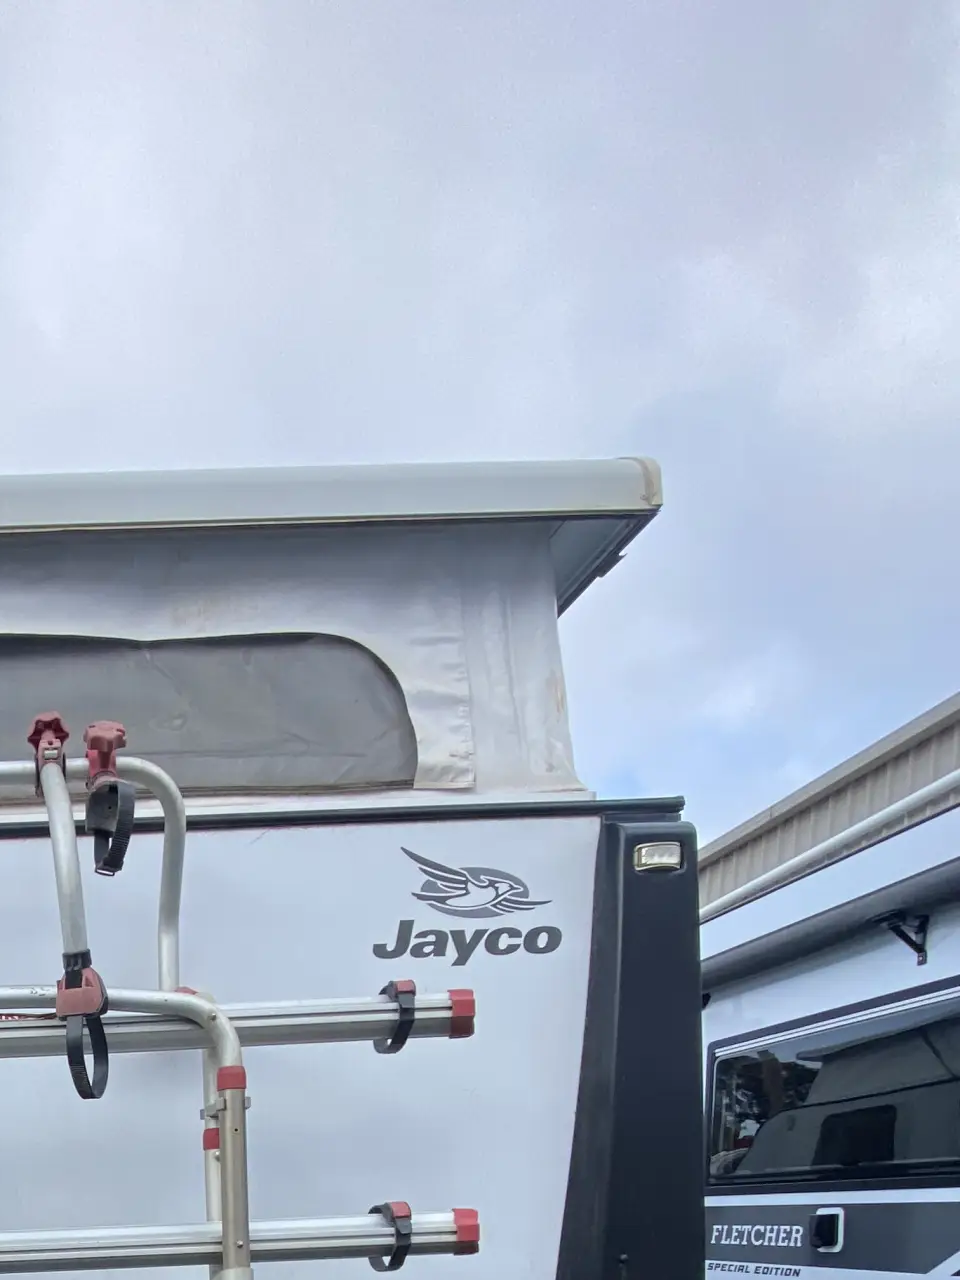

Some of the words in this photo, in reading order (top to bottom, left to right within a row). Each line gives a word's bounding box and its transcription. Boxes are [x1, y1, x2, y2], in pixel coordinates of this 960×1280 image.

[372, 919, 562, 966] Jayco
[710, 1224, 804, 1248] FLETCHER
[707, 1262, 751, 1274] SPECIAL
[754, 1265, 801, 1277] EDITION
